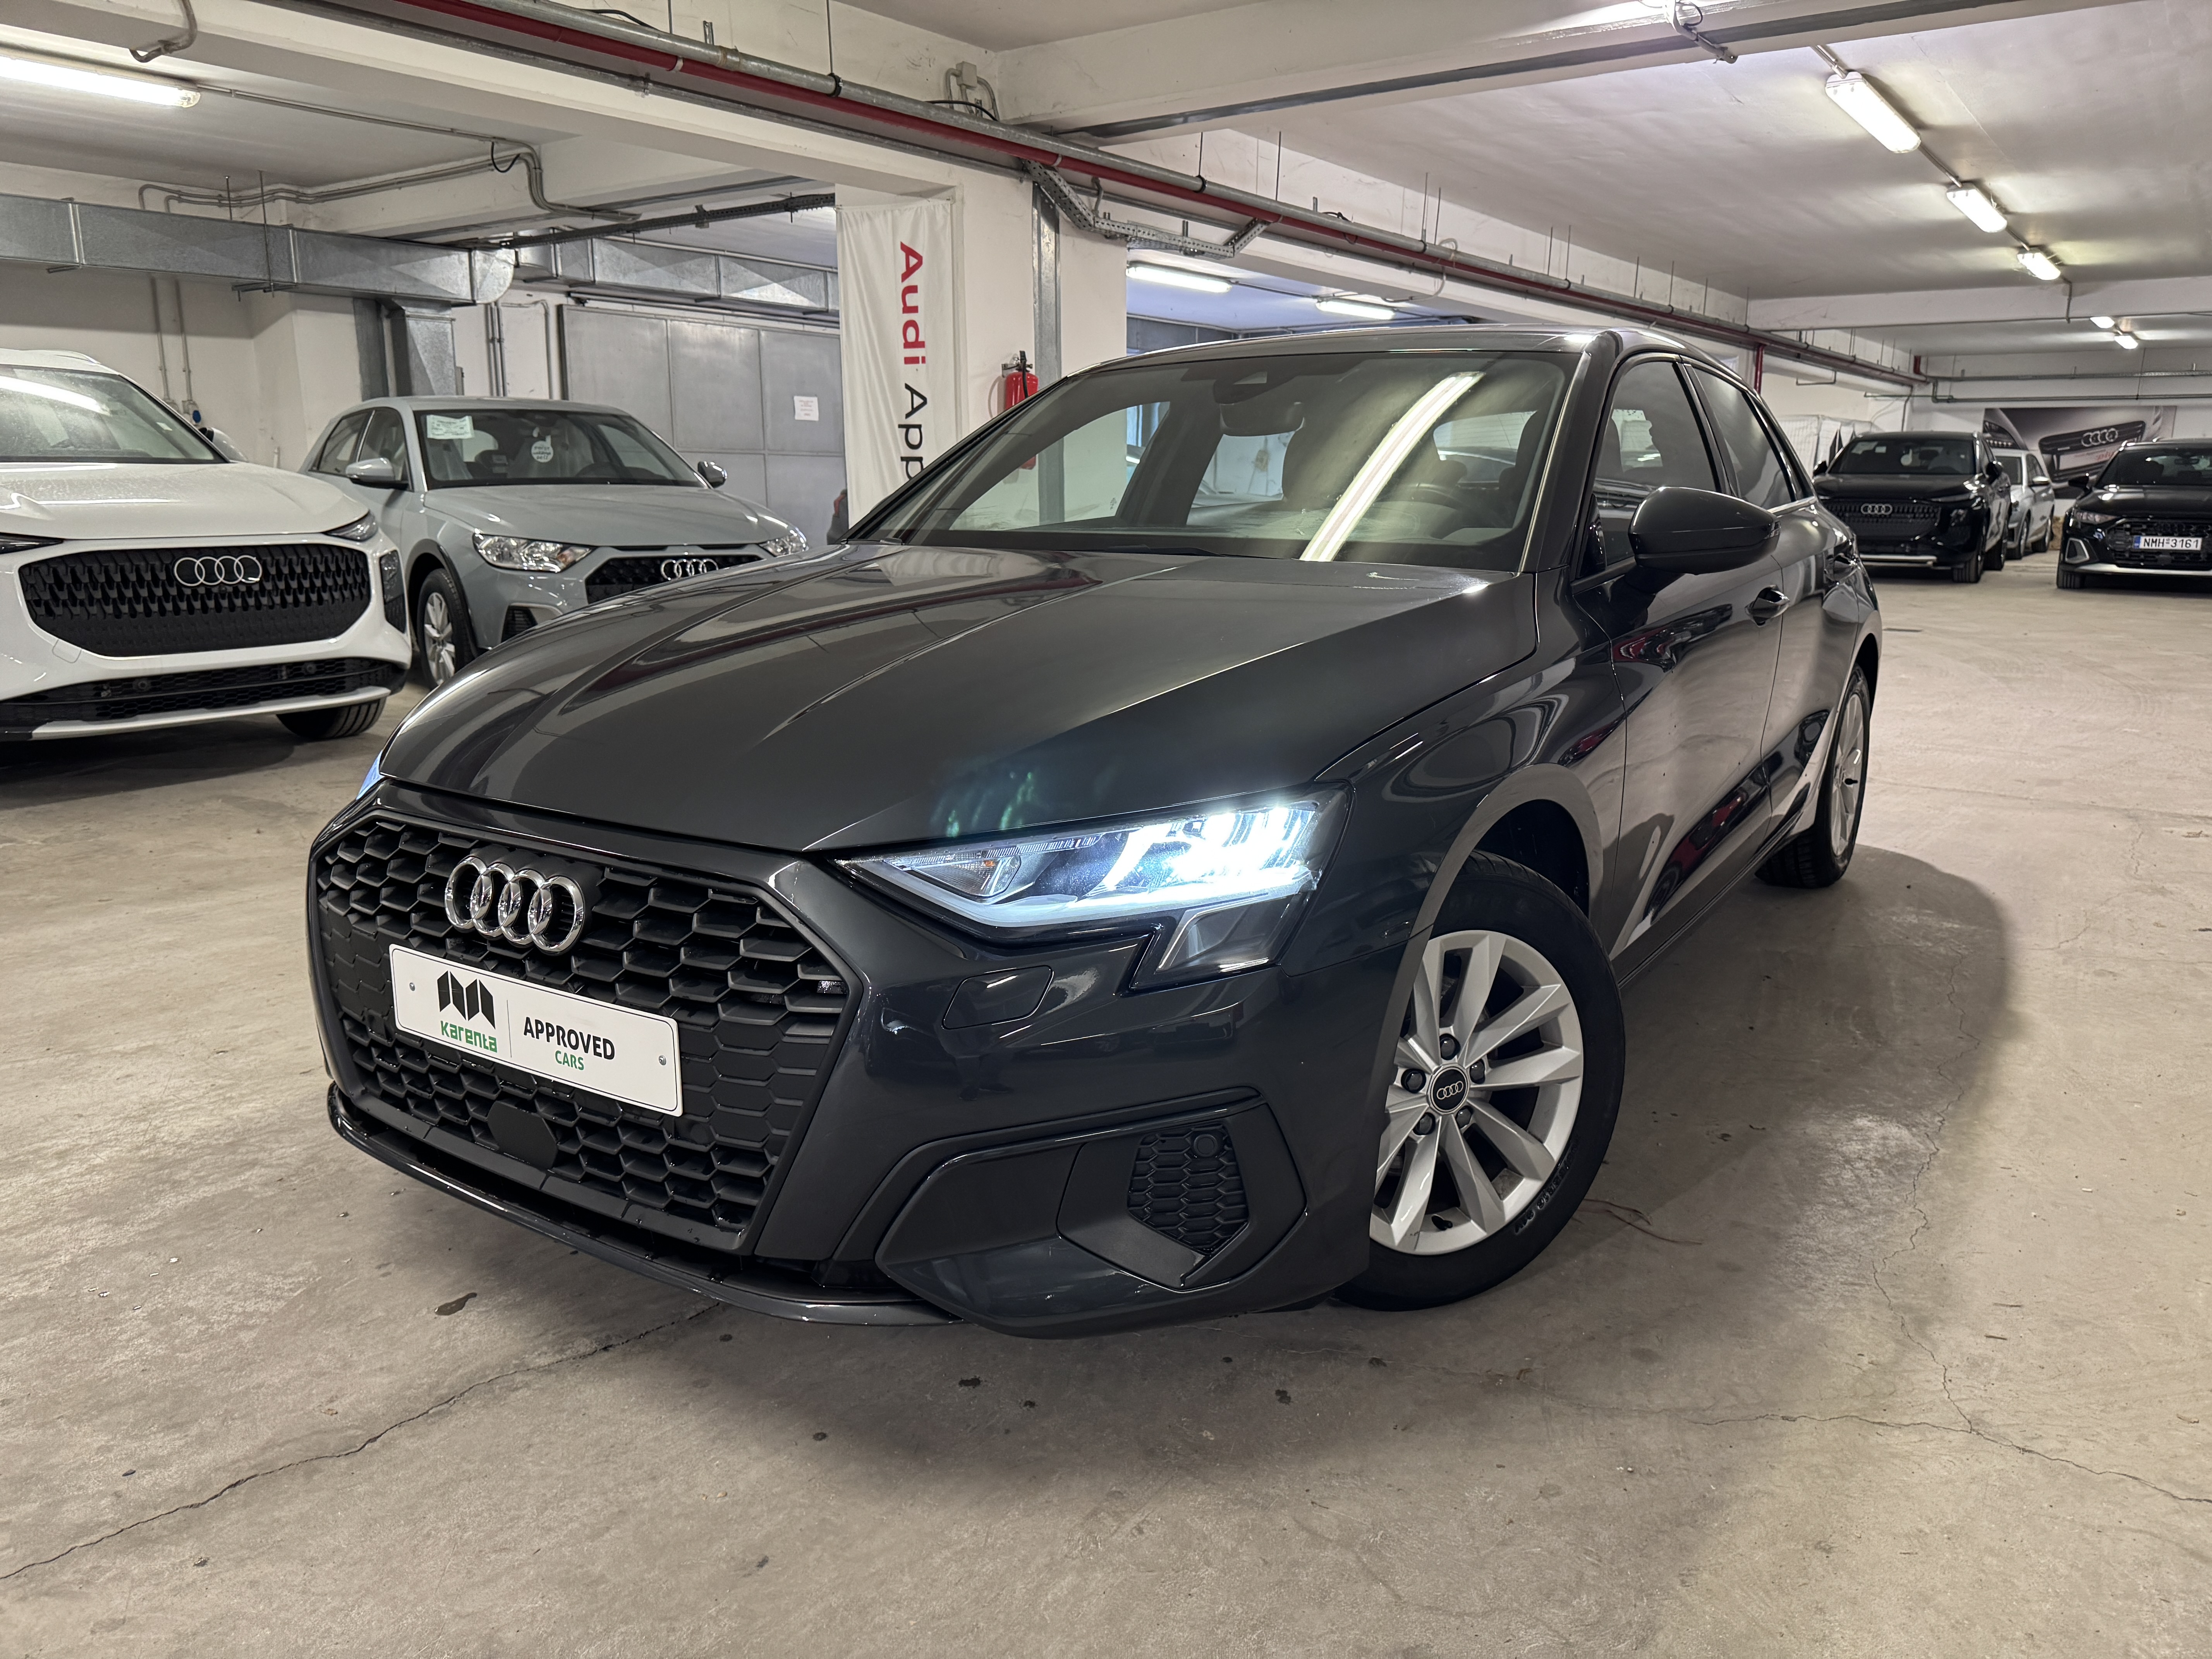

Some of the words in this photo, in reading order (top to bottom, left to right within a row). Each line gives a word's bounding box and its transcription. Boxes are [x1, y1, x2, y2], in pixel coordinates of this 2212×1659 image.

[900, 241, 926, 364] Audi
[524, 1017, 615, 1060] APPROVED
[555, 1050, 584, 1070] CARS
